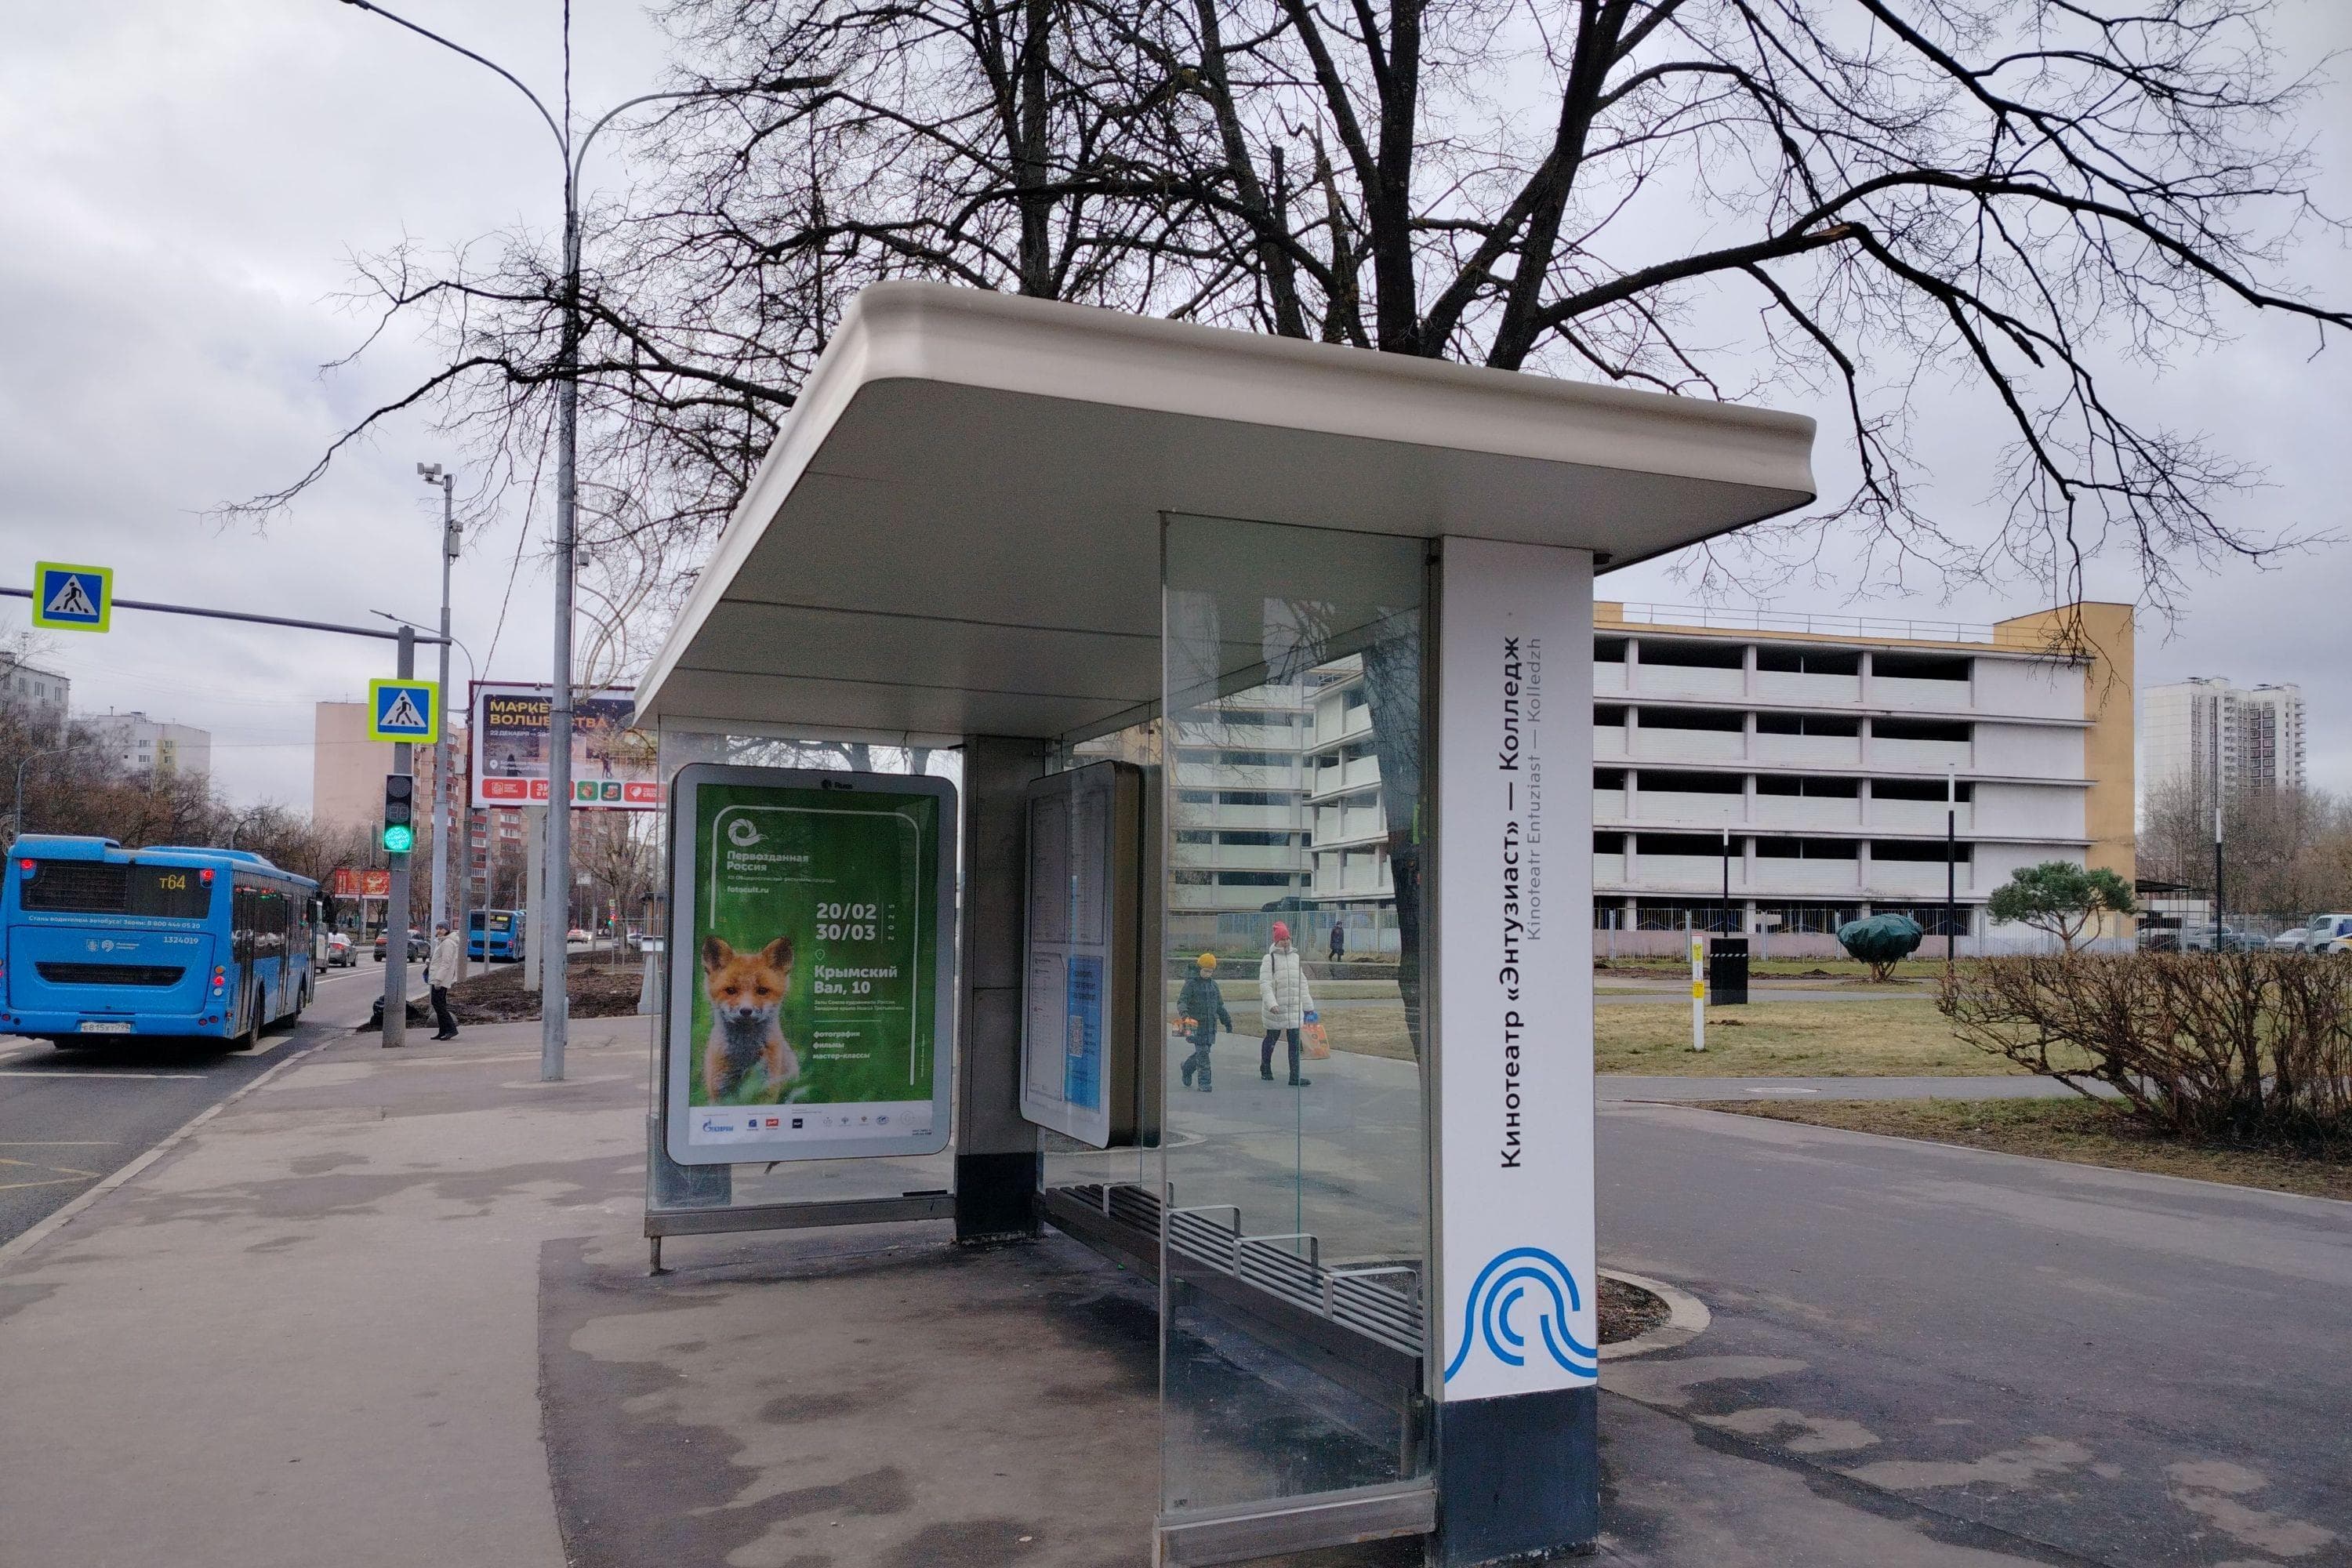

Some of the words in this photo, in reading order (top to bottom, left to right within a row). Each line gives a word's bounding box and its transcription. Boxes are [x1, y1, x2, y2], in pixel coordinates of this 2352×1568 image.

[1526, 638, 1541, 722] Kolledzh
[1499, 637, 1523, 771] Колледж
[1527, 754, 1541, 844] Entuziast
[727, 850, 809, 862] Первозданная
[727, 861, 768, 872] Россия
[1527, 851, 1541, 940] Kinoteatr
[816, 902, 877, 920] 20/02
[1499, 821, 1523, 1001] «Энтузиаст»
[163, 936, 199, 945] 1324019
[815, 924, 877, 941] 30/03
[814, 964, 898, 981] Крымский
[814, 981, 848, 996] Вал,
[851, 981, 871, 994] 10
[1501, 1011, 1524, 1168] Кинотеатр
